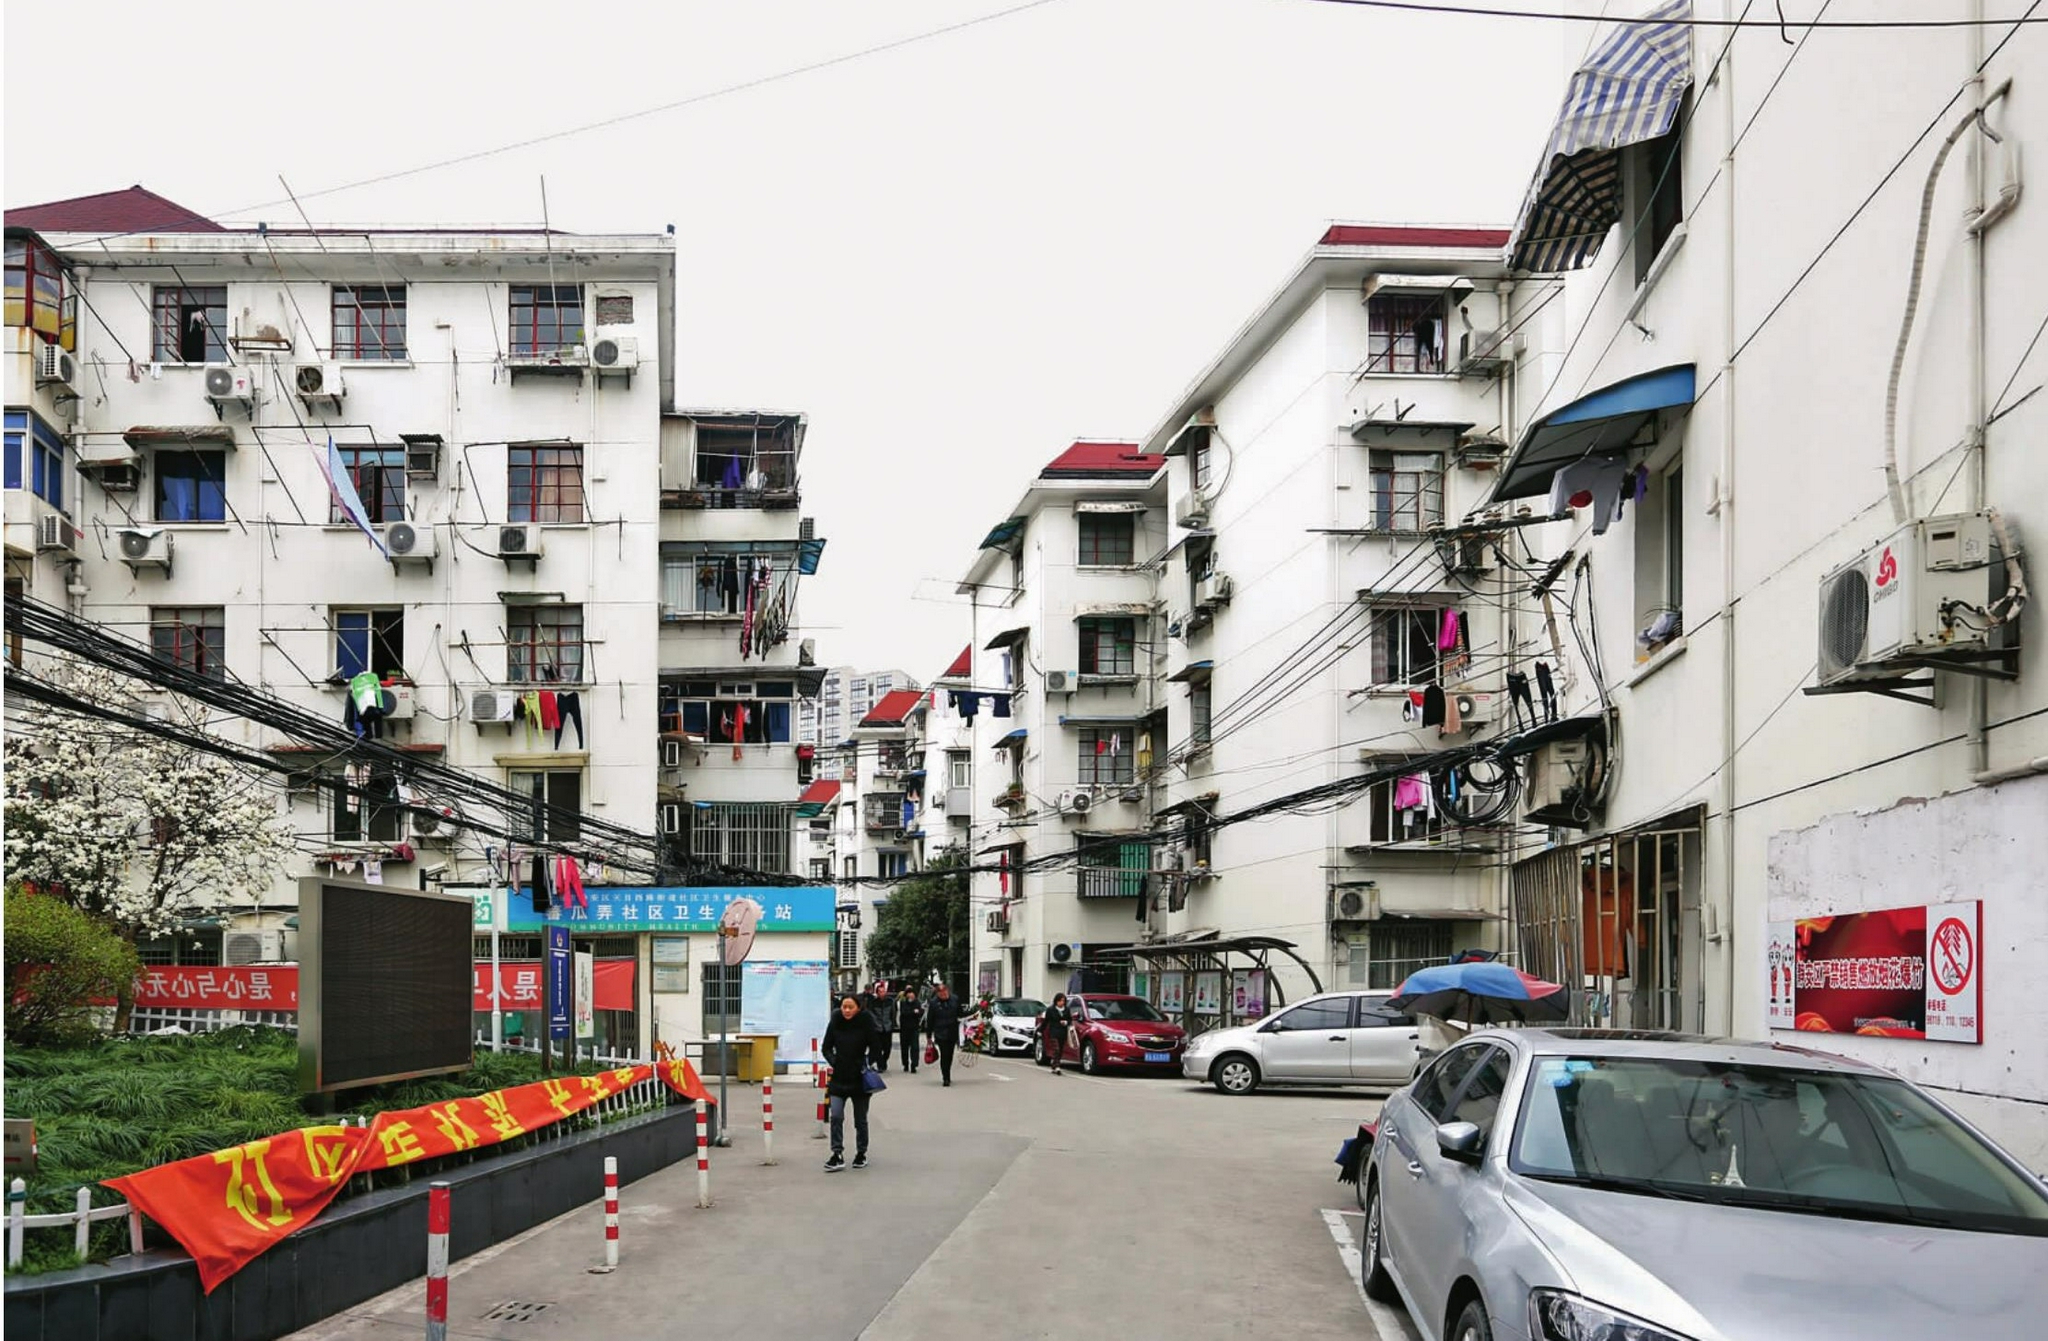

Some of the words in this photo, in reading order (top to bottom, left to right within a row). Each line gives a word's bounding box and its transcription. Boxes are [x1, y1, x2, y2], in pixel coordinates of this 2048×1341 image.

[547, 903, 792, 920] 番瓜弄社区卫生站
